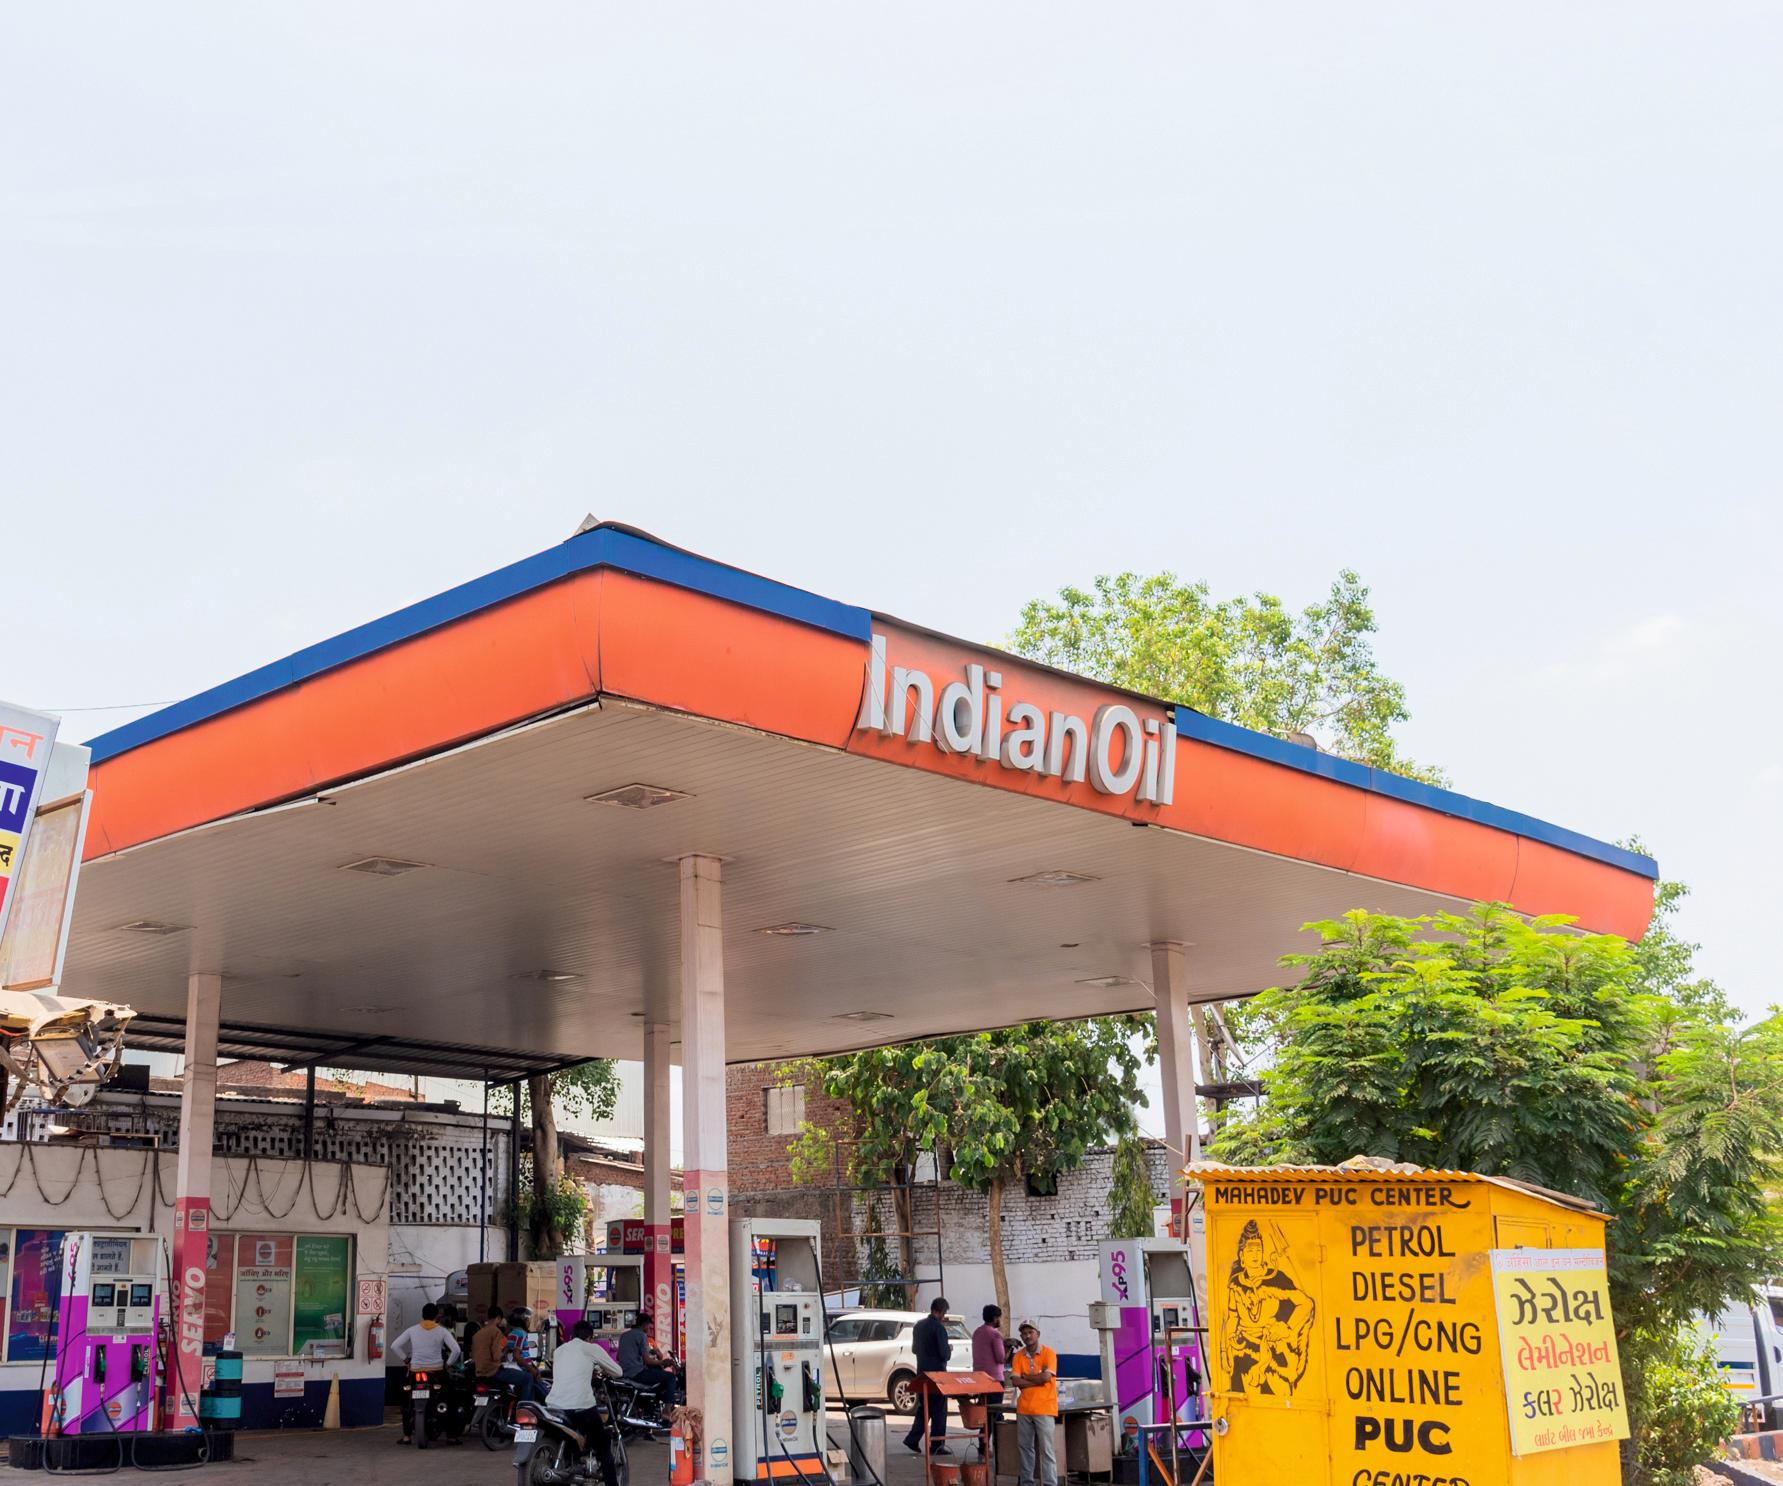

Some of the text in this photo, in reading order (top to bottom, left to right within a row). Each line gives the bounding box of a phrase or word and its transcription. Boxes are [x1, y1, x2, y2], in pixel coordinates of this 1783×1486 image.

[857, 634, 1177, 806] IndianOil
[1215, 1186, 1471, 1208] MAHADEV PUC CENTER
[1351, 1225, 1456, 1257] PETROL
[563, 1264, 574, 1304] XP95
[1112, 1250, 1129, 1301] XP95
[1352, 1271, 1457, 1304] DIESEL
[181, 1267, 206, 1357] SERVO
[1510, 1277, 1604, 1326] ઝેરોક્ષ
[1335, 1308, 1482, 1357] LPG/CNG
[1518, 1333, 1611, 1371] લેમીનેશન
[1345, 1367, 1463, 1406] ONLINE
[1523, 1371, 1619, 1419] કલર ઝેરોક્ષ
[1354, 1416, 1453, 1456] PUC
